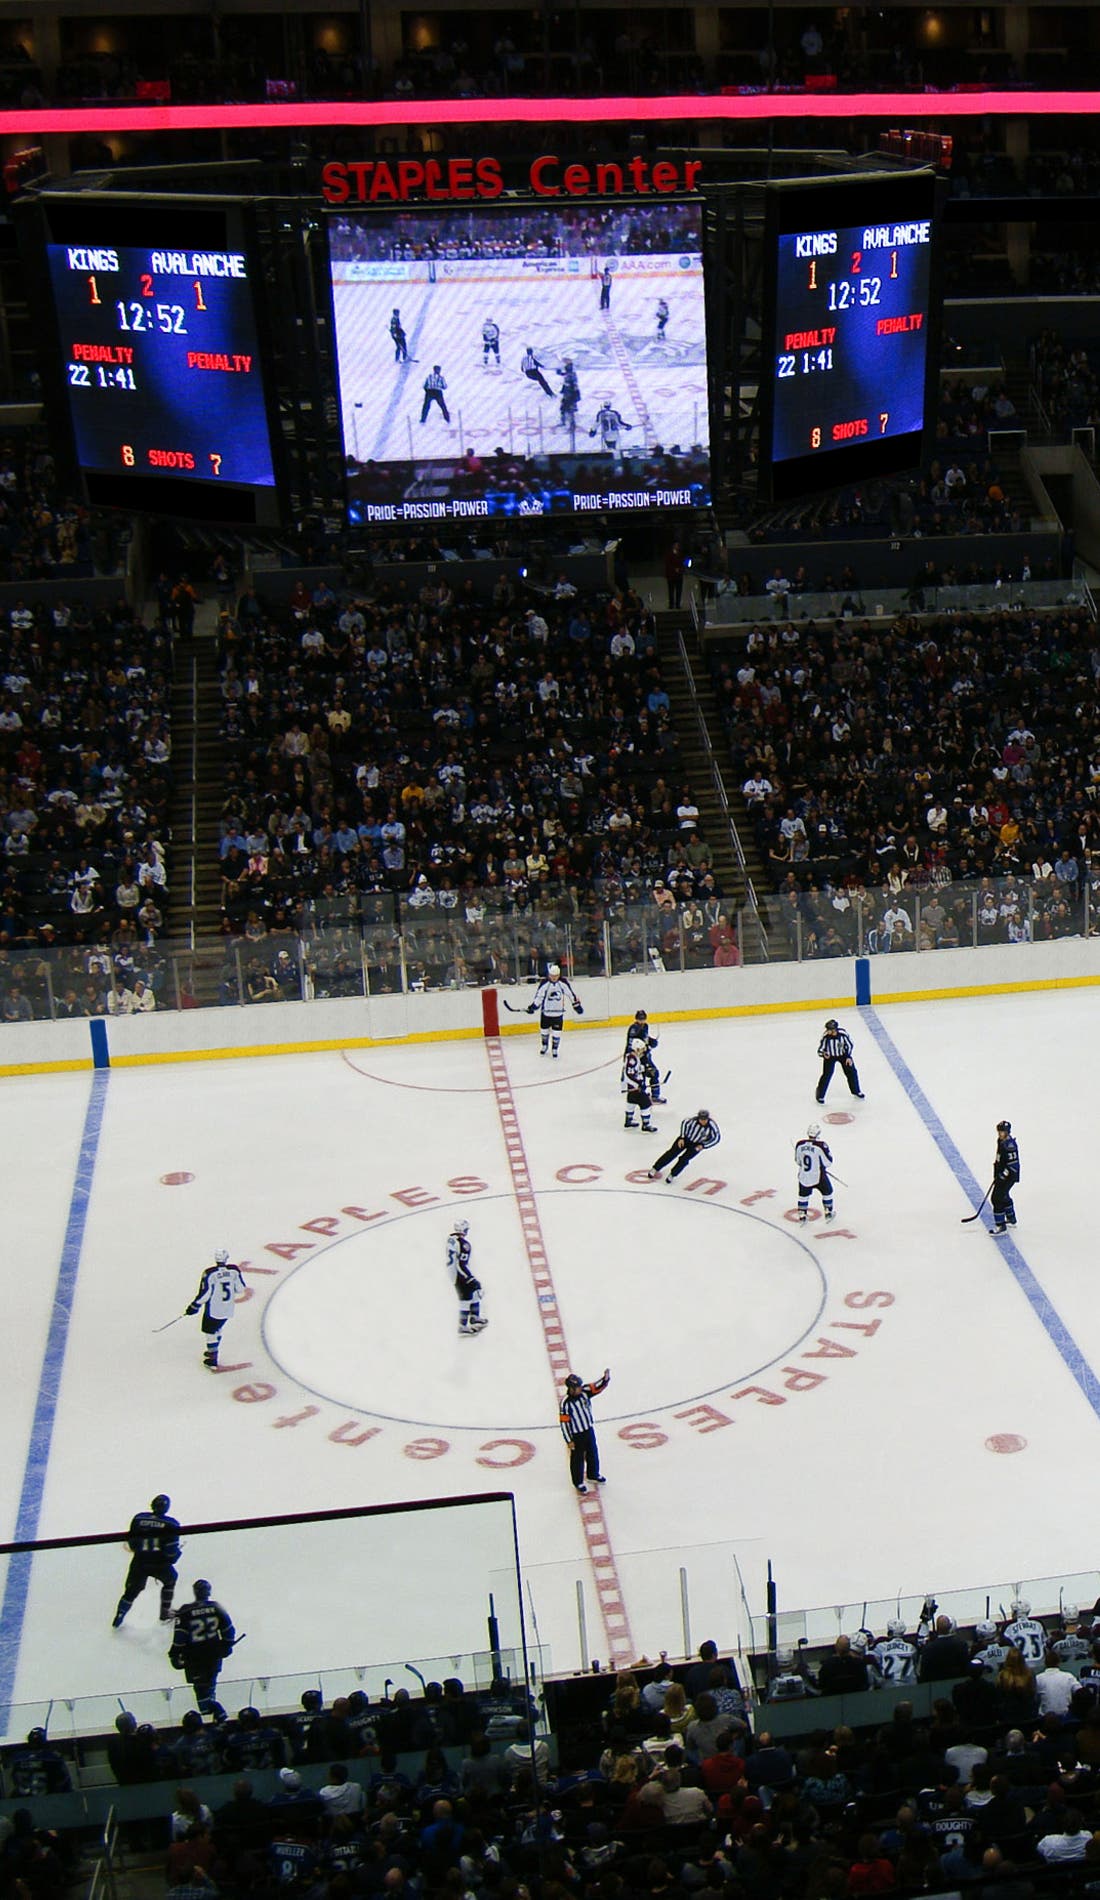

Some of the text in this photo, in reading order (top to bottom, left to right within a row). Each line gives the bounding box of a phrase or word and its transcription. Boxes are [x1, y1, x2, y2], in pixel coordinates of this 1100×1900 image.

[322, 155, 702, 202] STAPLES Center
[796, 222, 930, 257] KINGS AVALANCHE
[67, 248, 247, 278] KINGS AVALANCHE
[808, 251, 898, 289] 1 2 1
[88, 274, 206, 309] 1 2 1
[829, 277, 881, 311] 12:52
[117, 301, 187, 334] 12:52
[785, 313, 923, 350] PENALTY PENALTY
[73, 343, 251, 373] PENALTY PENALTY
[778, 348, 833, 378] 22 1:41
[69, 364, 136, 390] 22 1:41
[812, 413, 889, 448] 8 SHOTS 7
[122, 445, 222, 475] 8 SHOTS 7
[803, 1155, 812, 1172] 9
[234, 1175, 488, 1303] TAPLES
[220, 1282, 231, 1302] 5
[617, 1290, 896, 1450] STAPLES
[884, 1654, 912, 1680] 27
[935, 1821, 973, 1832] DOUGHTY
